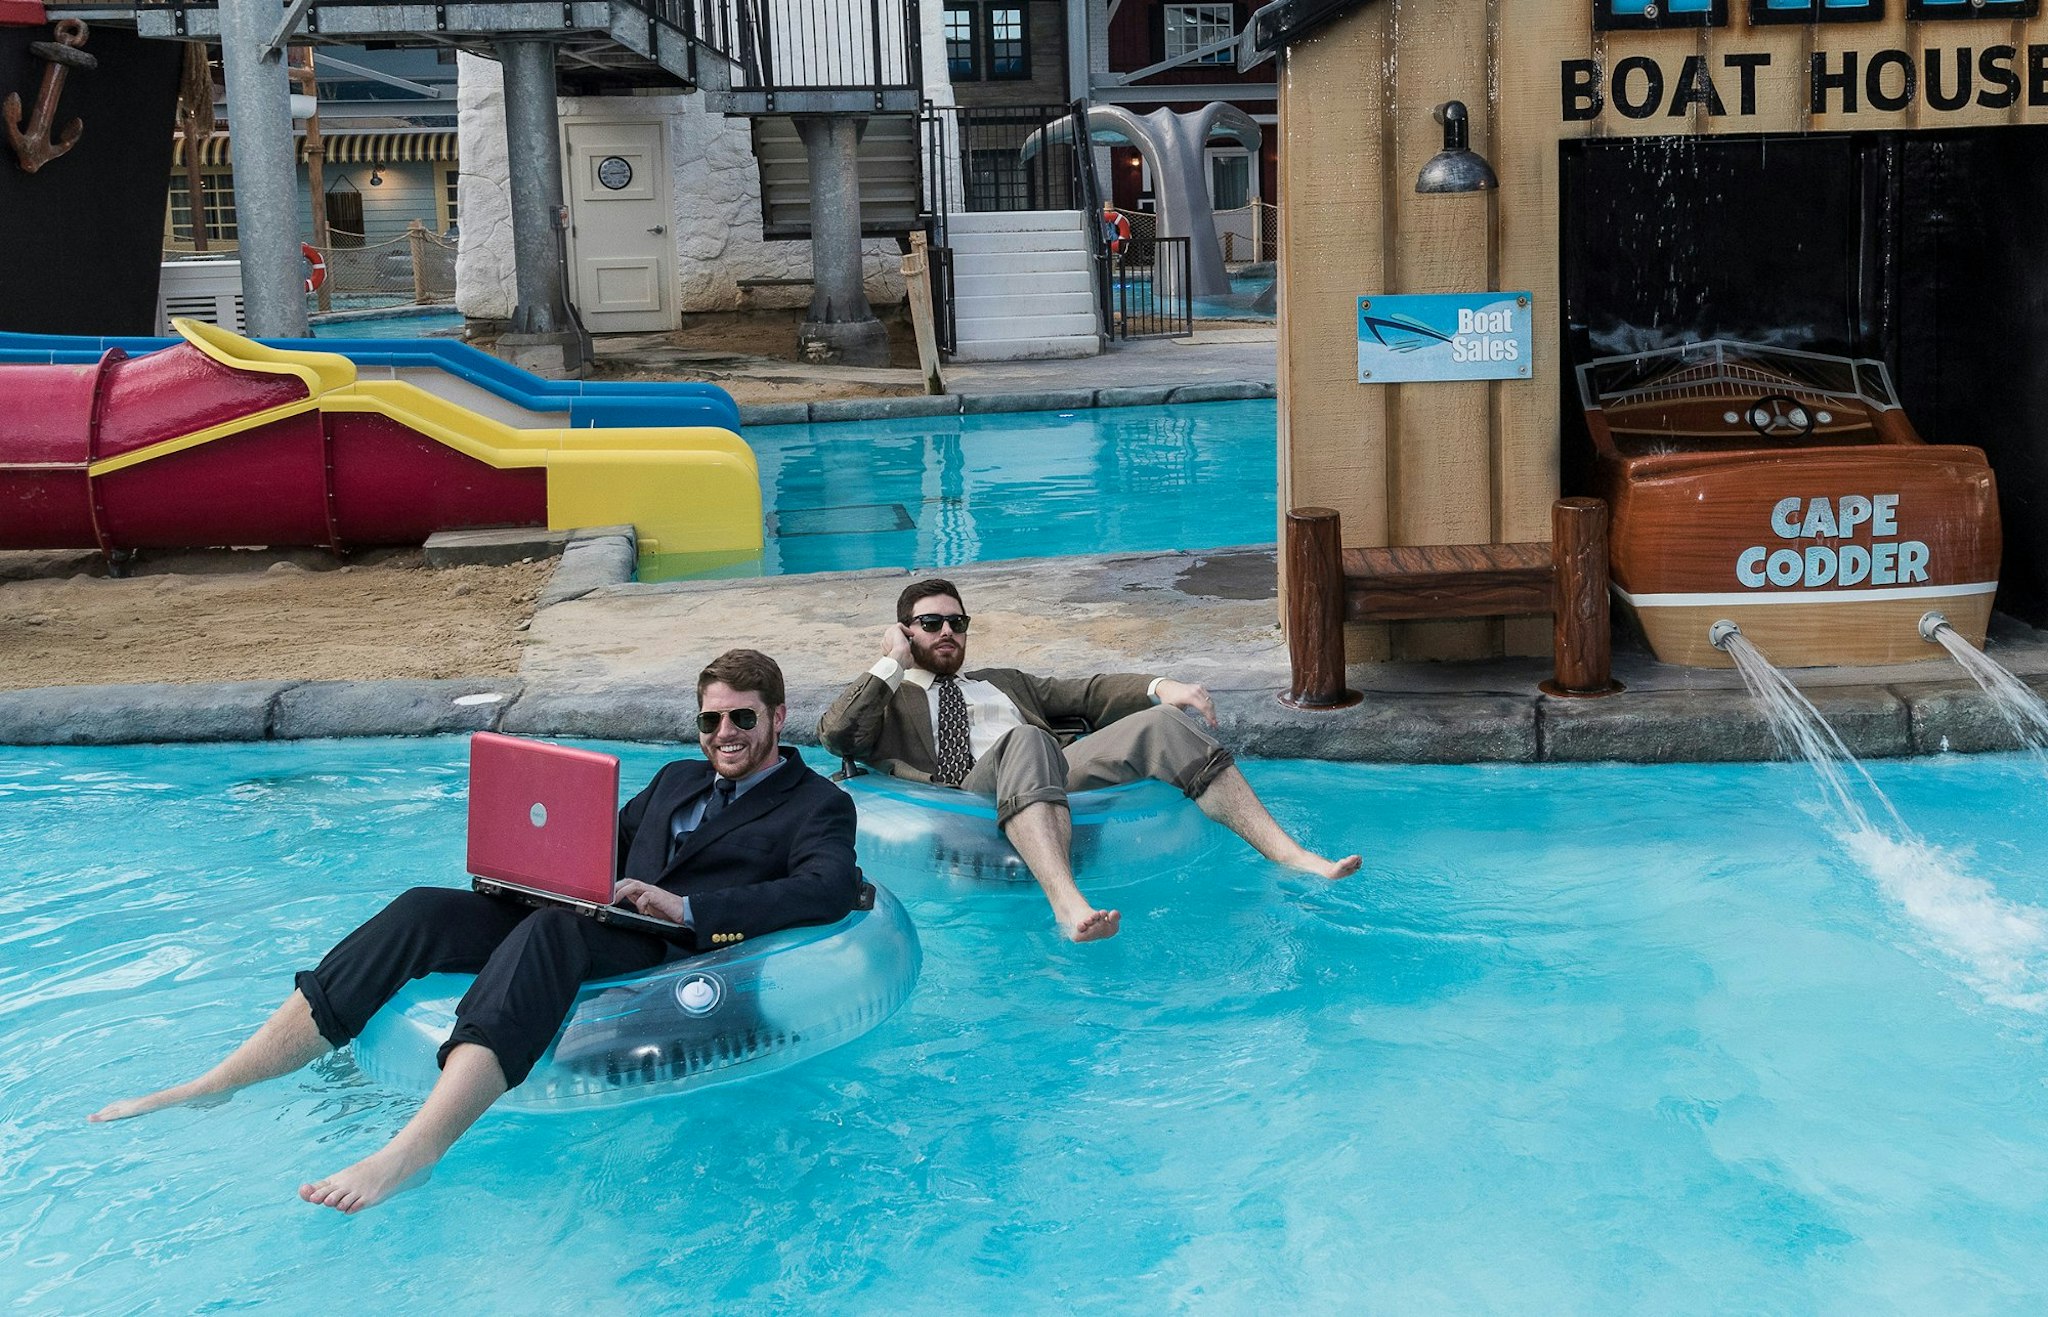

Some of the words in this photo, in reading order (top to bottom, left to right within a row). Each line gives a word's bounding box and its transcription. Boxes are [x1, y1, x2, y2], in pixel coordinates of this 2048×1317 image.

[1561, 53, 1771, 122] BOAT
[1458, 308, 1513, 335] Boat
[1452, 335, 1519, 363] Sales
[1771, 493, 1900, 539] CAPE
[1736, 540, 1931, 588] CODDER
